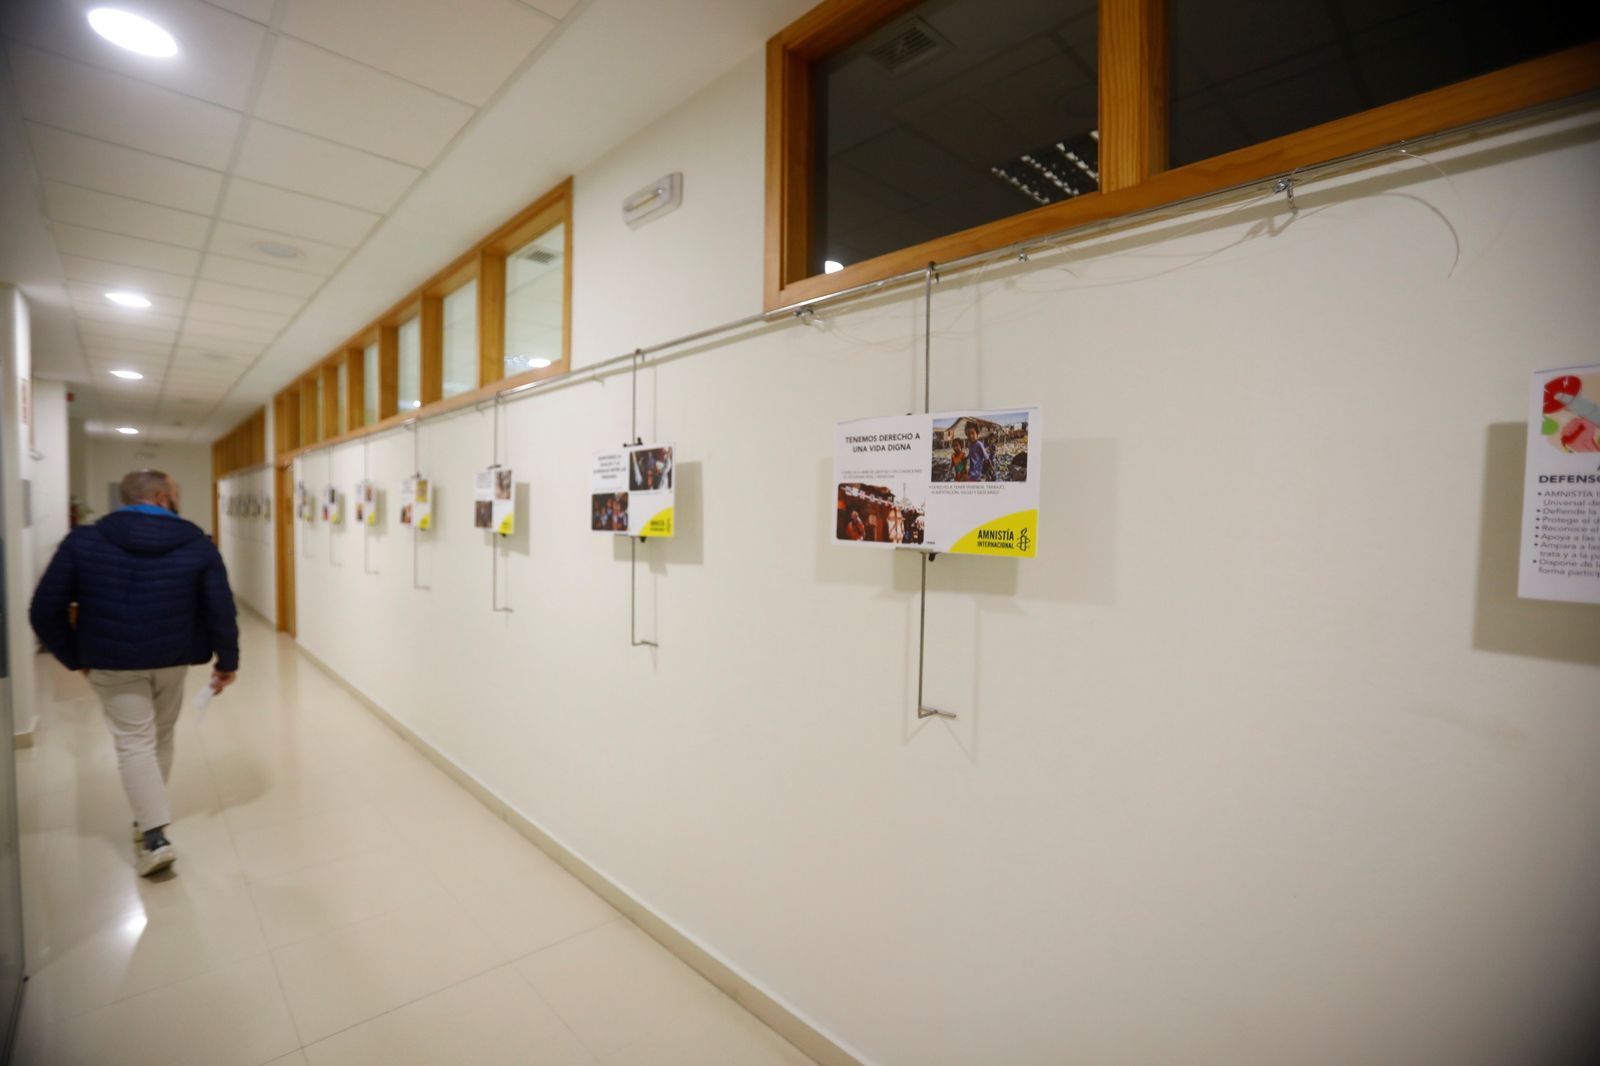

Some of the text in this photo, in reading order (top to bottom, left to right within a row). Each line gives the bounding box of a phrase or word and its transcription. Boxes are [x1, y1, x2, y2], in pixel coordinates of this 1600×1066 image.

[845, 432, 921, 443] TENEMOS DERECHO A
[888, 443, 911, 451] DIGNA
[1542, 516, 1579, 524] Protege
[978, 528, 1014, 541] AMNISTÍA
[1541, 533, 1570, 541] Apoya
[977, 541, 1014, 549] INTERNACIONAL
[1540, 542, 1576, 550] Ampara
[1539, 558, 1578, 567] Dispone
[1538, 566, 1565, 574] forma
